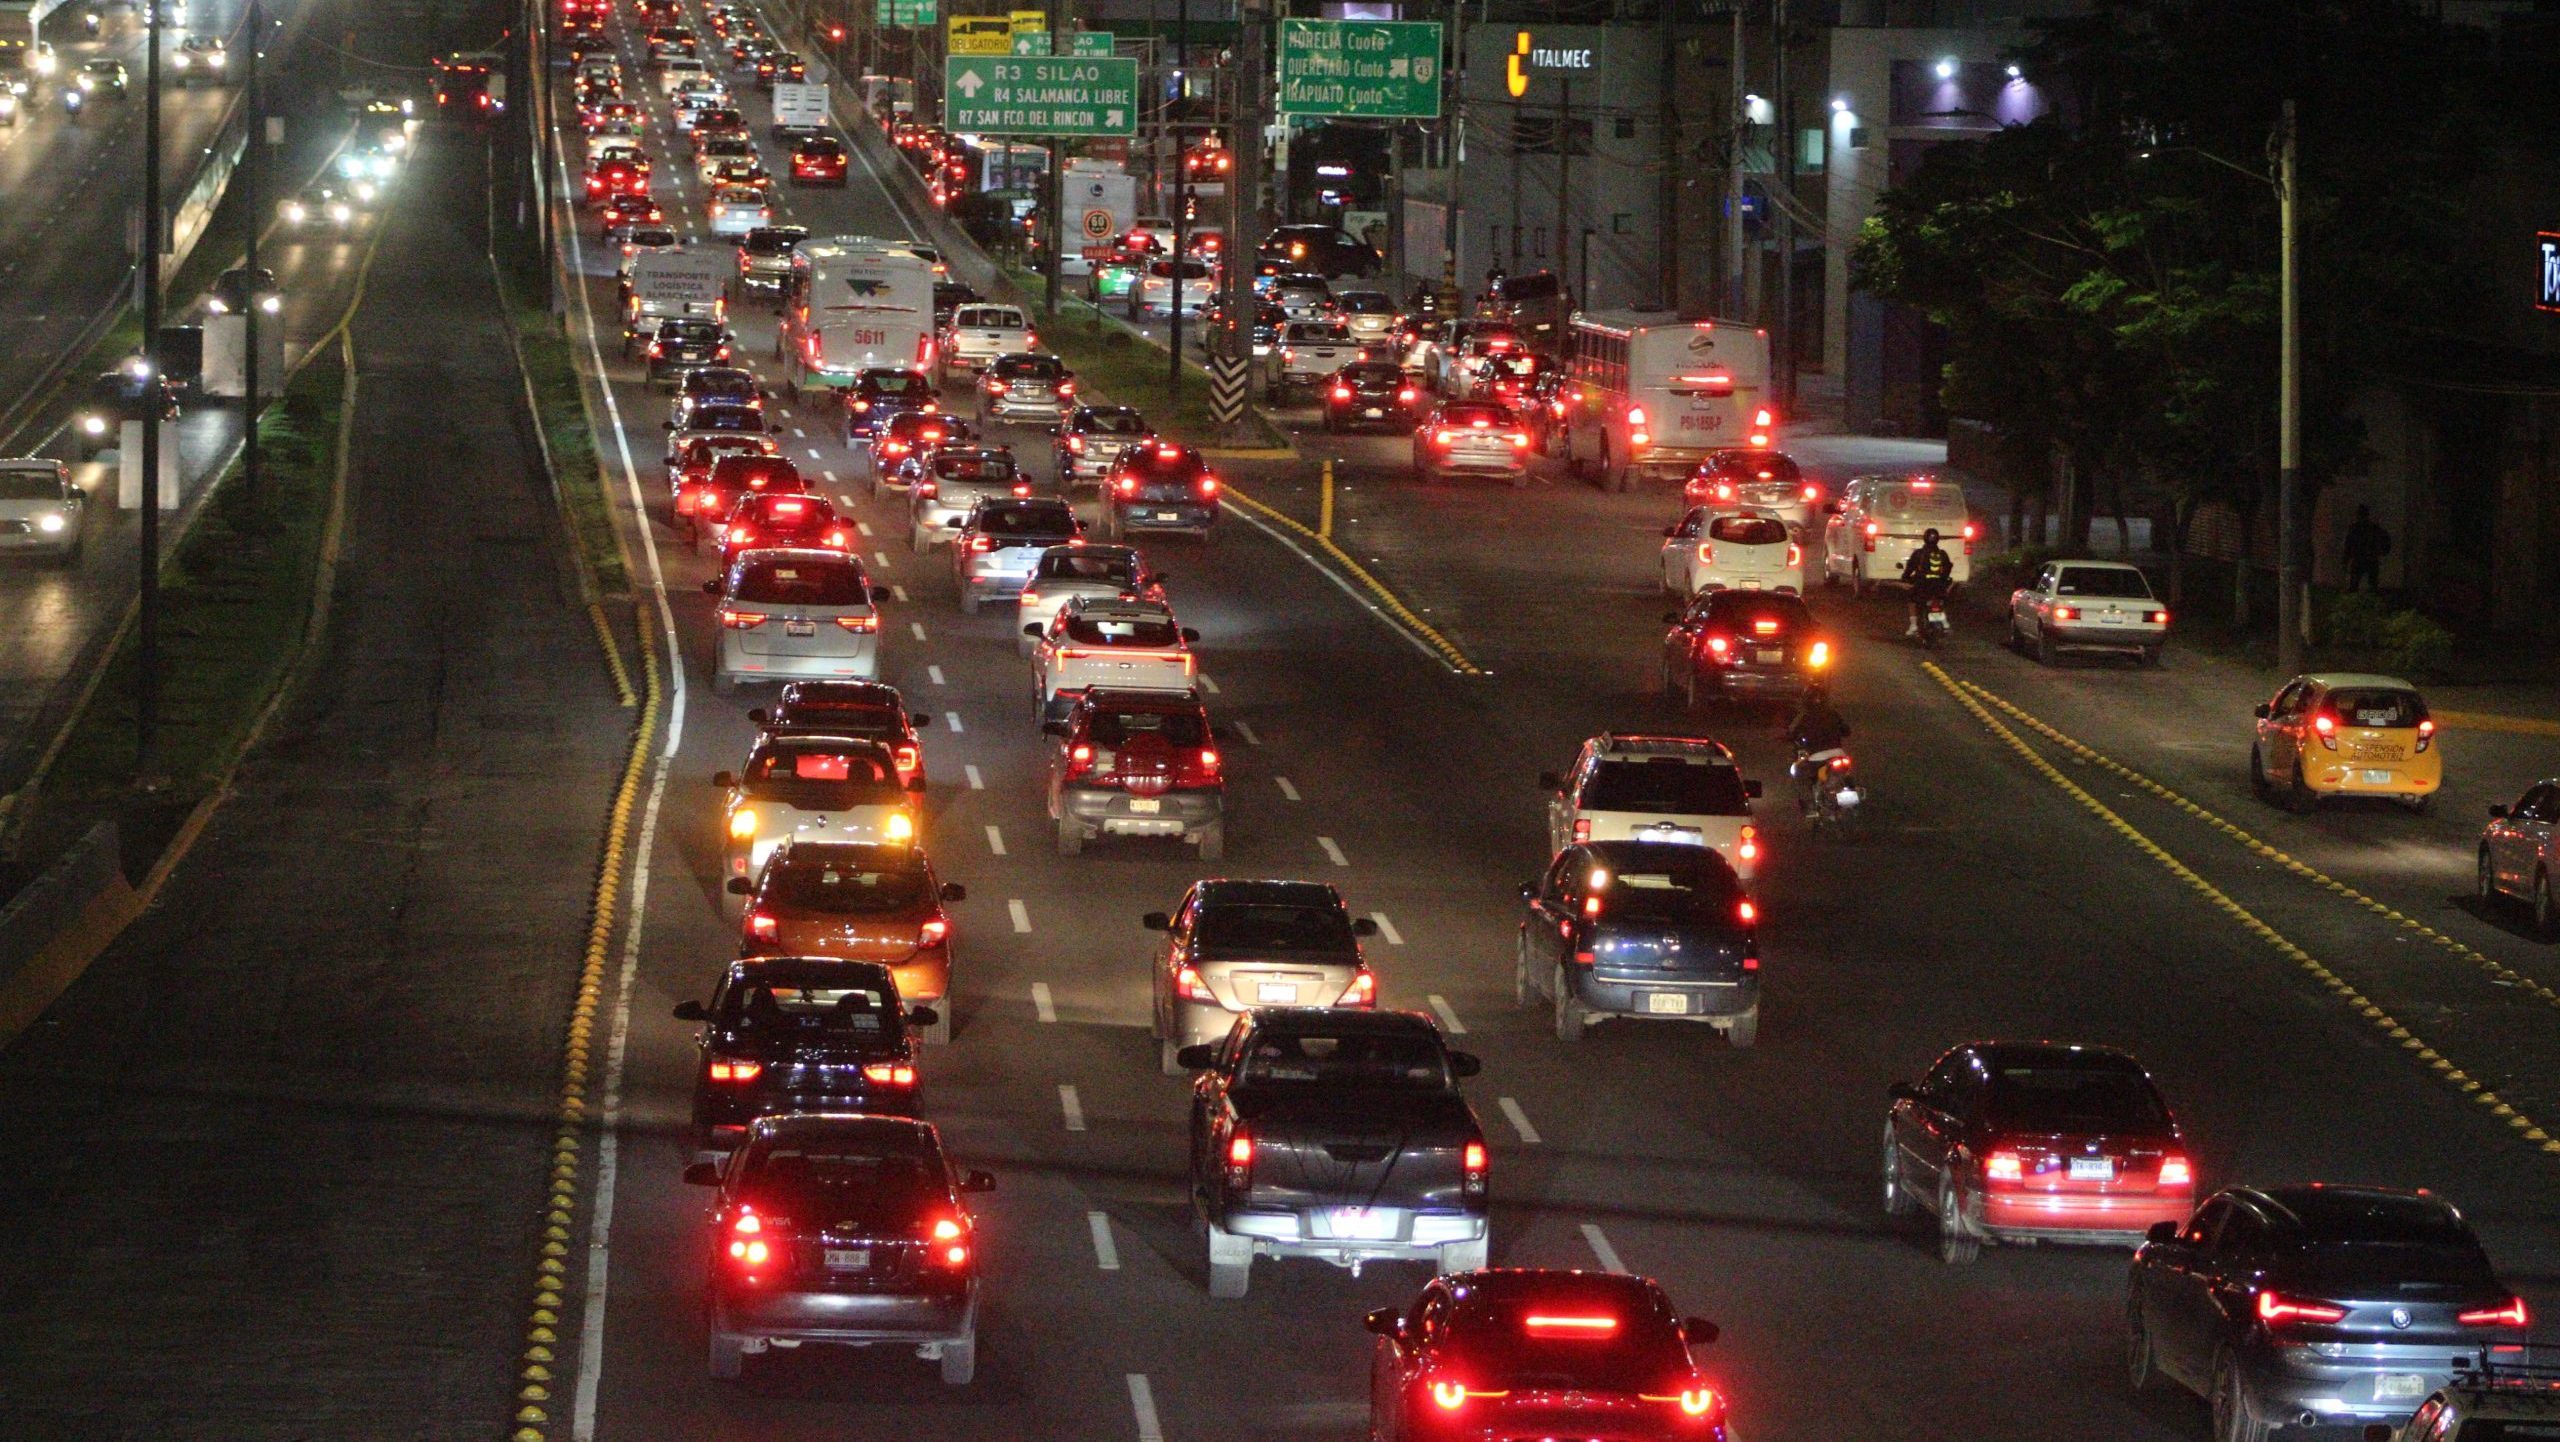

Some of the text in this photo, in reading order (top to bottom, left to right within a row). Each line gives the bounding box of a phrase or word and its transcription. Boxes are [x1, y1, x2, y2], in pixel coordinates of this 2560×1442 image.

[950, 38, 1009, 50] OBLIGATORIO
[1288, 31, 1385, 51] MORELIA Cuota
[1532, 49, 1591, 68] ITALMEC
[995, 65, 1100, 81] R3 SILAO
[1353, 59, 1384, 77] Cuota
[1417, 64, 1430, 78] 43
[994, 87, 1130, 105] R4 SALAMANCA LIBRE
[1286, 81, 1383, 104] IRAPUATO Cuota
[959, 110, 973, 125] R7
[977, 110, 999, 125] SAN
[1029, 110, 1049, 126] DEL
[1053, 111, 1094, 127] RINCON
[1091, 216, 1105, 227] 60
[646, 271, 710, 281] TRANSPORTE
[854, 329, 886, 346] 5611
[764, 1217, 792, 1227] NASA
